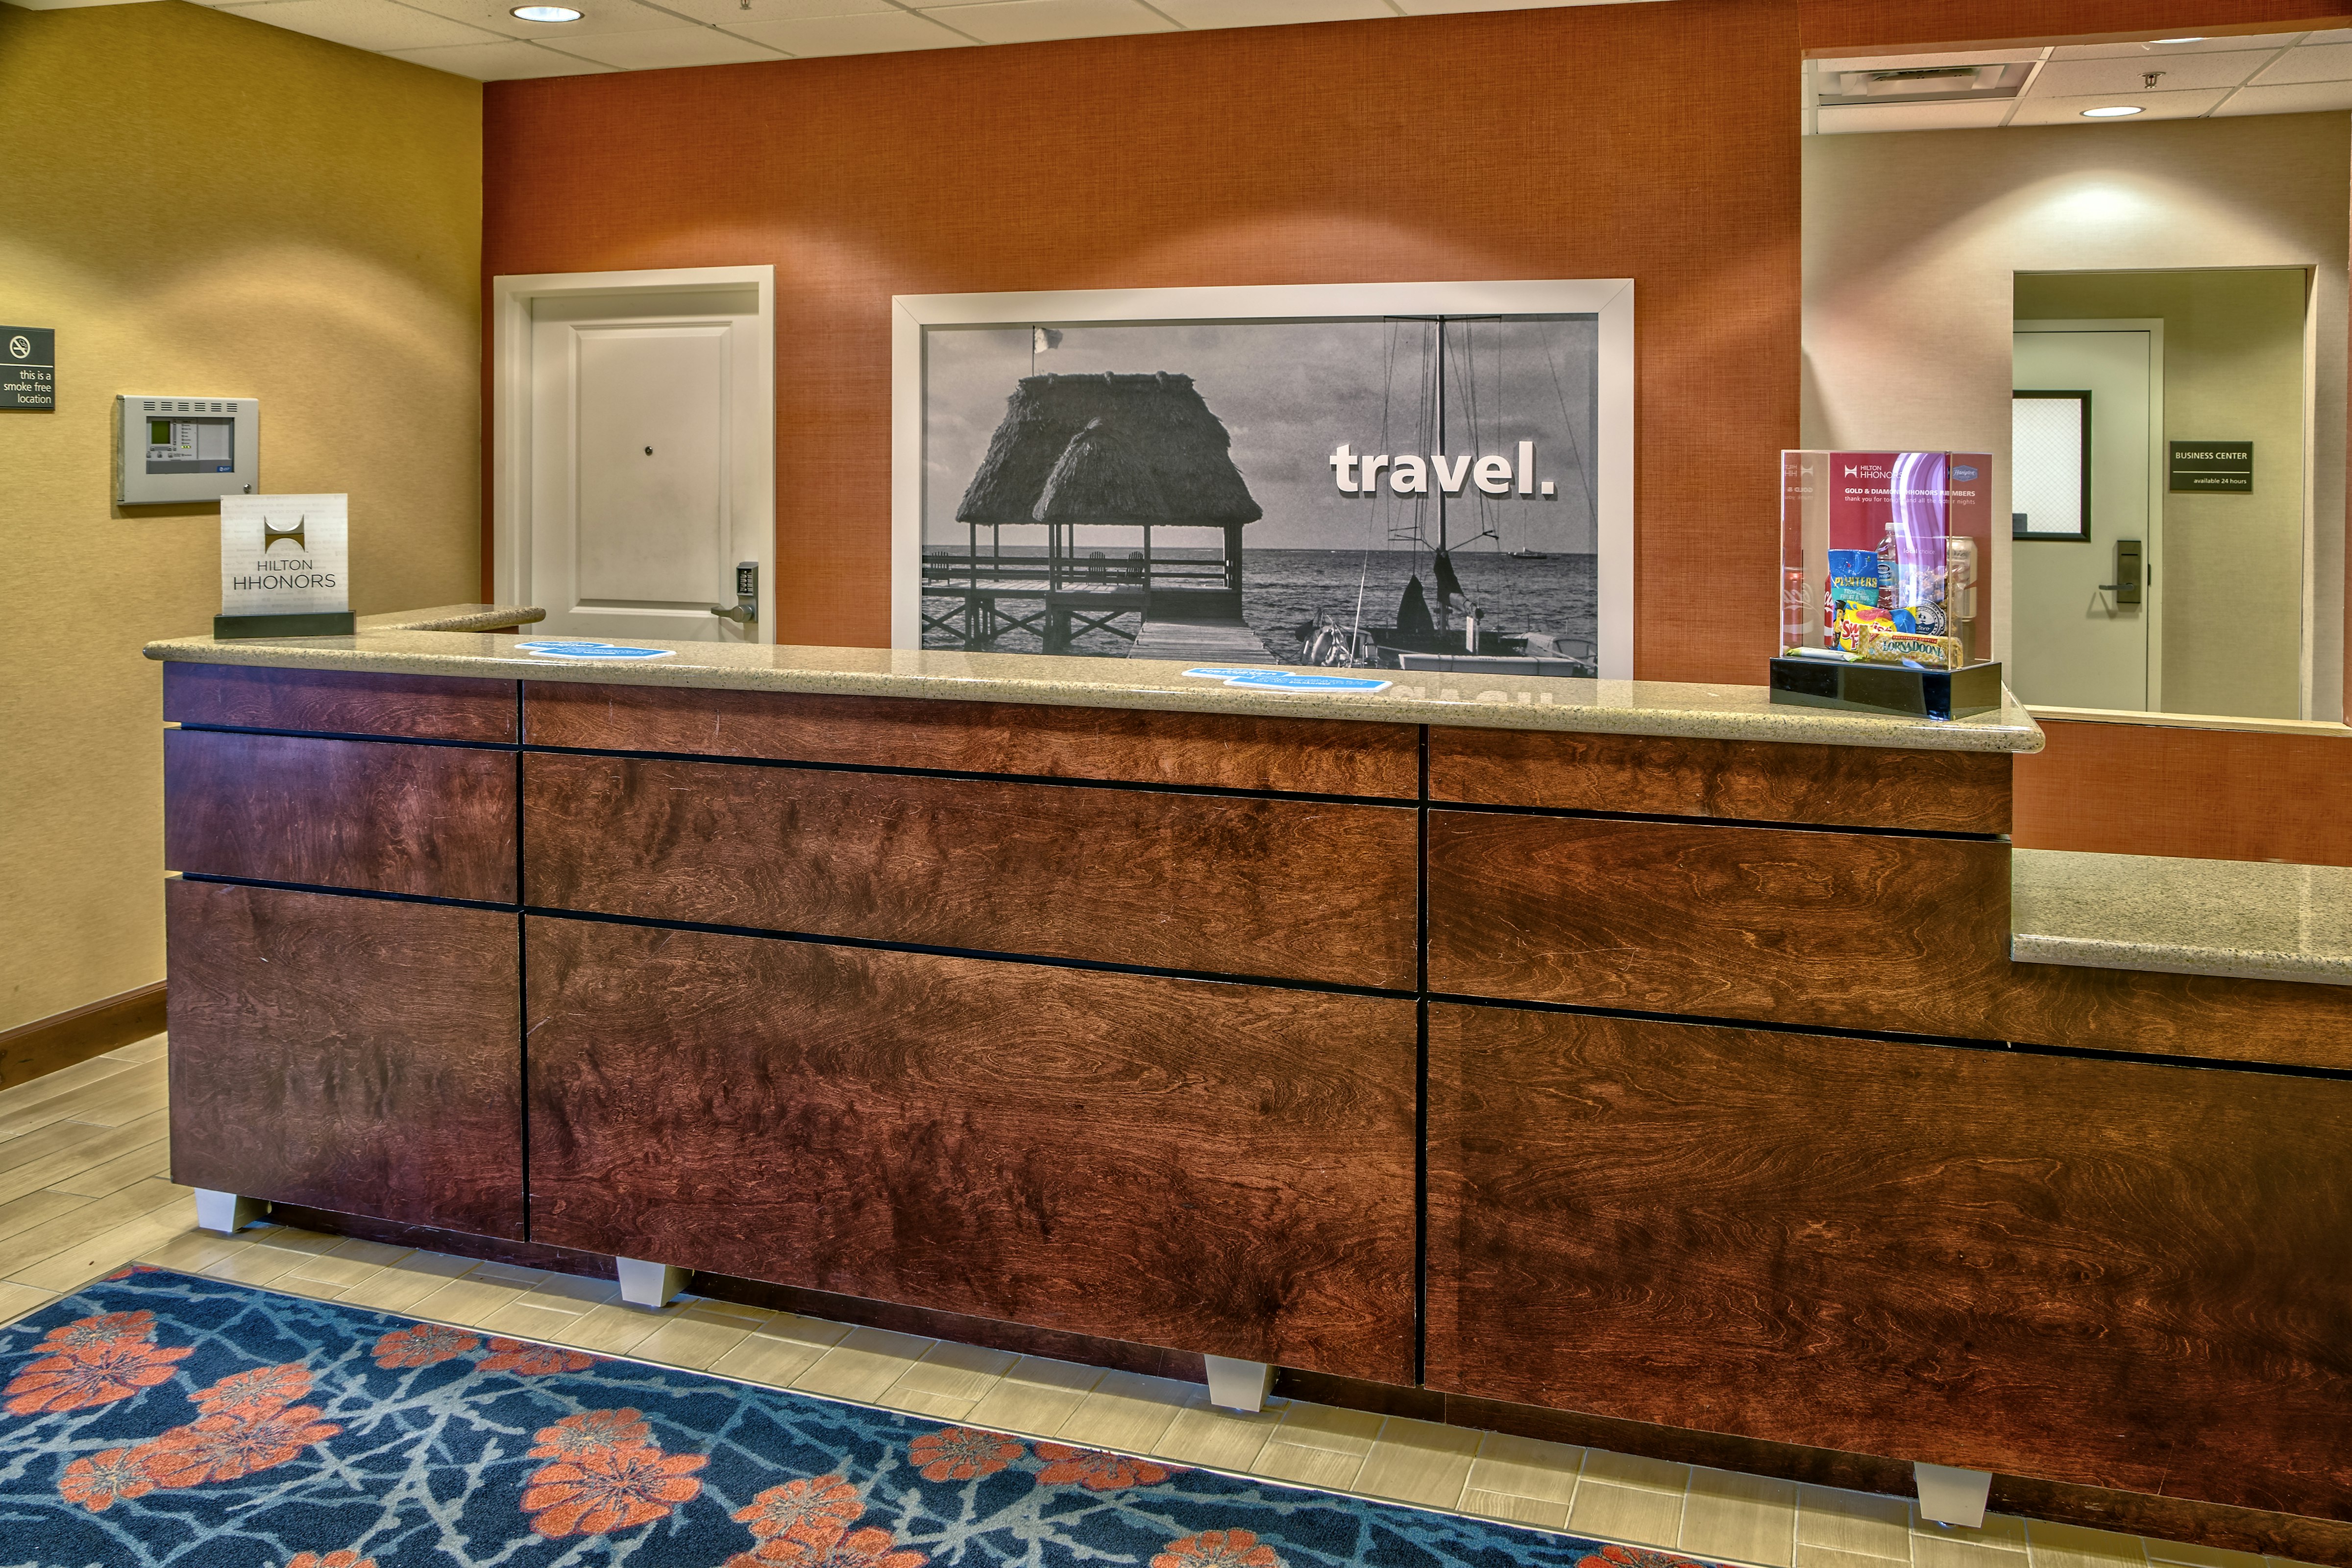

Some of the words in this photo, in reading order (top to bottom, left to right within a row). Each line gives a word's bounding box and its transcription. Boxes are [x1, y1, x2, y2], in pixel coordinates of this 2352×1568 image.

[20, 369, 36, 380] this
[37, 370, 44, 380] is
[3, 381, 32, 391] smoke
[34, 382, 51, 392] free
[17, 393, 51, 404] location
[1329, 441, 1554, 494] travel.
[257, 560, 313, 571] HILTON
[234, 574, 336, 590] HHONORS
[1834, 577, 1878, 588] PLANTERS
[1920, 601, 1938, 612] OPCORN
[1882, 640, 1912, 653] LORNA
[1912, 640, 1944, 657] DOONE
